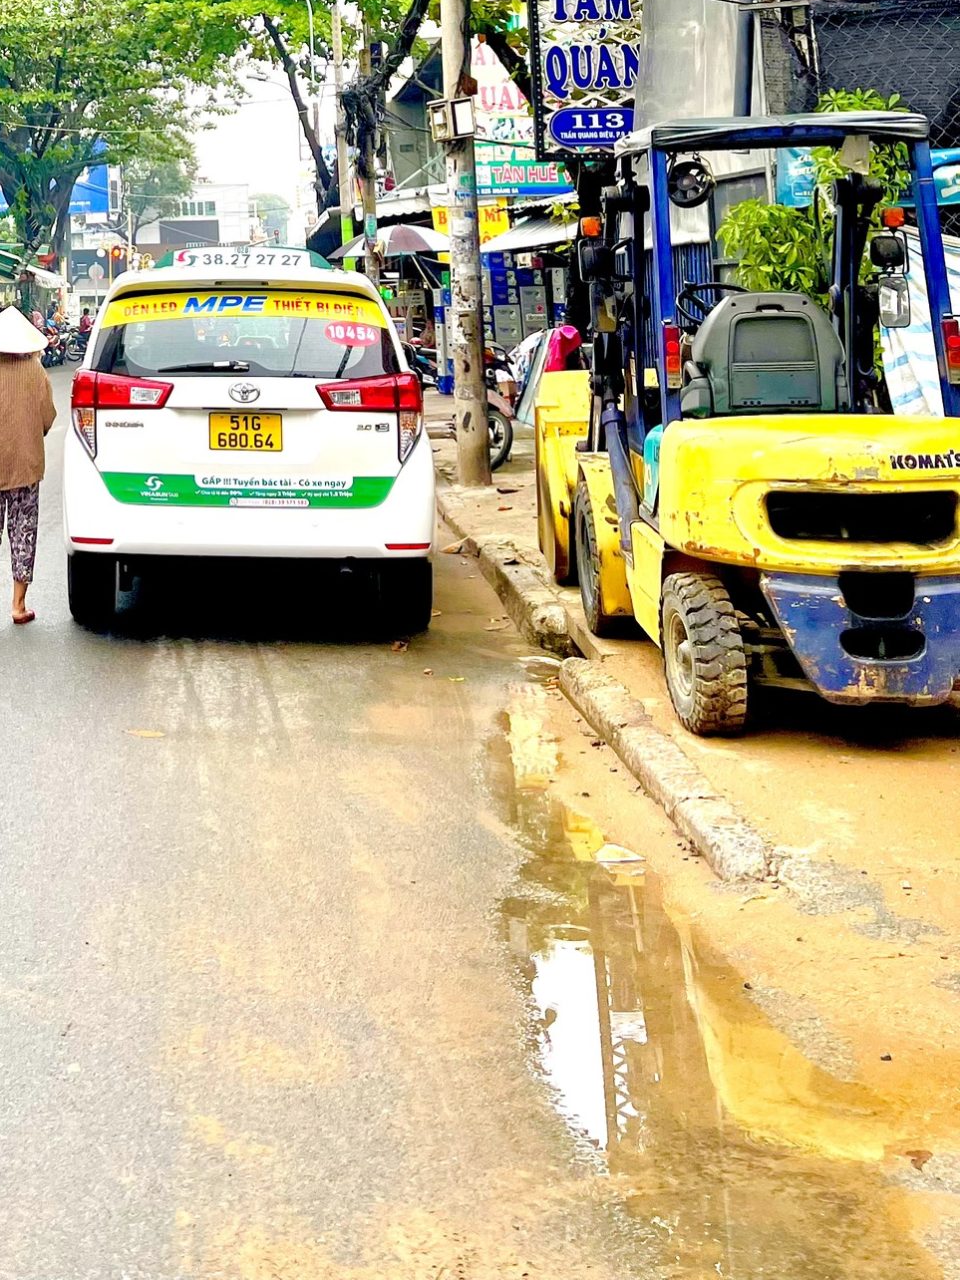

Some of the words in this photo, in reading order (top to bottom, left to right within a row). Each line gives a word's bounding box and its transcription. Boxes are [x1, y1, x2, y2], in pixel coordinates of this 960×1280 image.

[546, 28, 640, 99] QUÁN
[572, 113, 624, 128] 113
[492, 162, 524, 183] TÂN
[202, 254, 250, 266] 38.27
[256, 254, 276, 266] 27
[282, 255, 302, 266] 27
[154, 302, 178, 314] LED
[183, 296, 268, 314] MPE
[274, 296, 310, 312] THIẾT
[316, 301, 329, 314] BỊ
[328, 324, 376, 340] 10454
[230, 416, 260, 431] 51G
[218, 432, 274, 448] 680.64
[262, 478, 278, 486] bác
[280, 478, 292, 486] tài
[298, 478, 310, 487] Có
[325, 480, 346, 488] ngay
